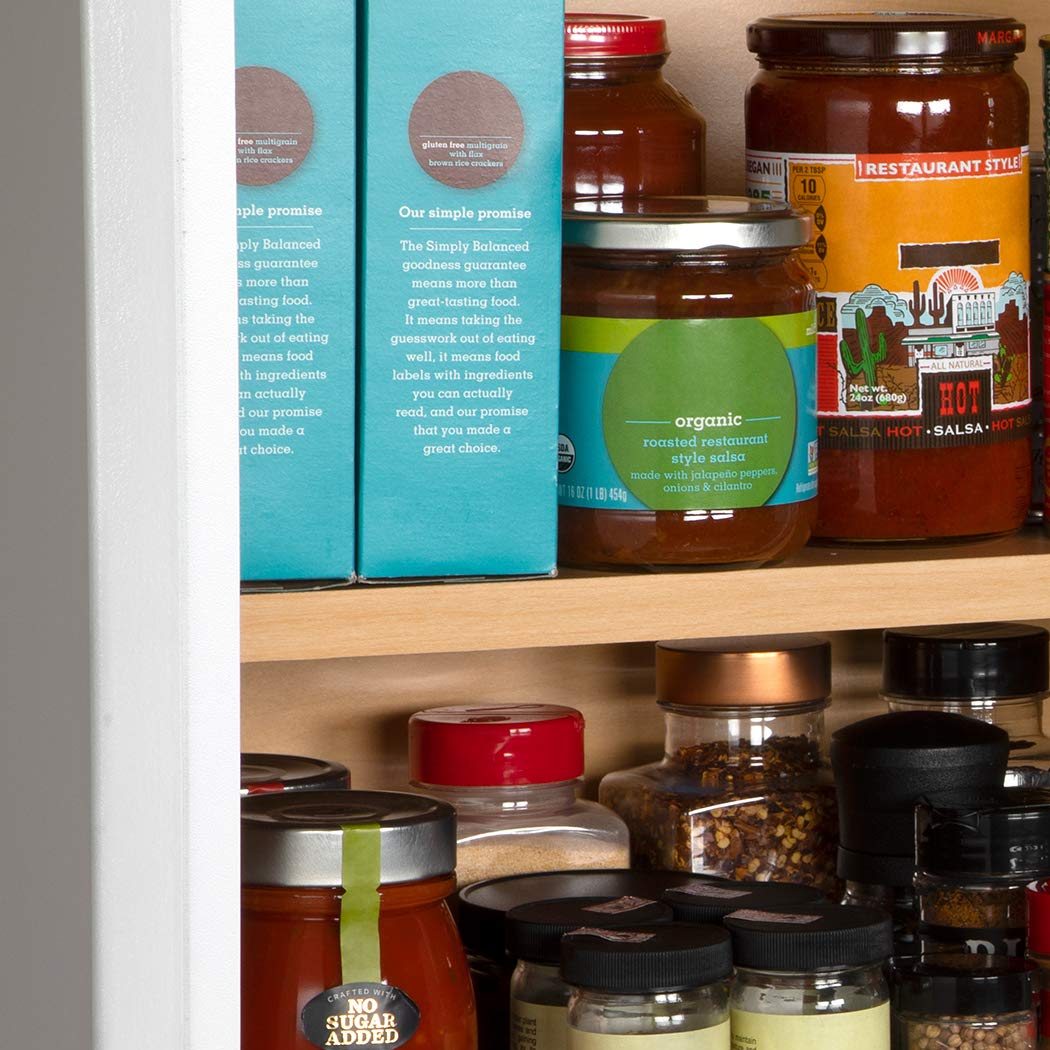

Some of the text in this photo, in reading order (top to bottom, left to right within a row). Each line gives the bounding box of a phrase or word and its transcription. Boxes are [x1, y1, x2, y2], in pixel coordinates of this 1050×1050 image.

[422, 141, 508, 150] gluten free multigrain
[428, 159, 504, 167] brown rice crackers
[747, 160, 771, 175] EGAN
[866, 157, 1019, 175] RESTAURANT STYLE
[801, 179, 816, 194] 10
[268, 205, 322, 218] promise
[399, 206, 532, 222] Our simple promise
[400, 240, 530, 254] The Simply Balanced
[254, 259, 318, 271] guarantee
[402, 259, 527, 272] goodness guarantee
[408, 296, 520, 309] great-tasting food.
[390, 332, 536, 346] guesswork out of eating
[931, 360, 984, 370] ALL NATURAL
[256, 370, 327, 382] ingredients
[392, 369, 534, 382] labels with ingredients
[255, 388, 306, 400] actually
[849, 384, 889, 393] Net wt.
[875, 393, 907, 404] (680g)
[939, 381, 980, 416] HOT
[675, 412, 742, 431] organic
[829, 427, 882, 438] SALSA
[887, 426, 923, 438] HOT
[992, 418, 1014, 431] HOT
[643, 433, 768, 449] roasted restaurant
[423, 443, 501, 456] great choice.
[671, 451, 746, 467] style salsa
[630, 470, 661, 480] made
[664, 469, 688, 480] with
[690, 468, 738, 482] jalapeño
[663, 481, 753, 493] onions & cilantro
[327, 988, 396, 1003] CRAFTED WITH
[348, 998, 378, 1014] NO
[326, 1013, 397, 1030] SUGAR
[325, 1028, 399, 1046] ADDED
